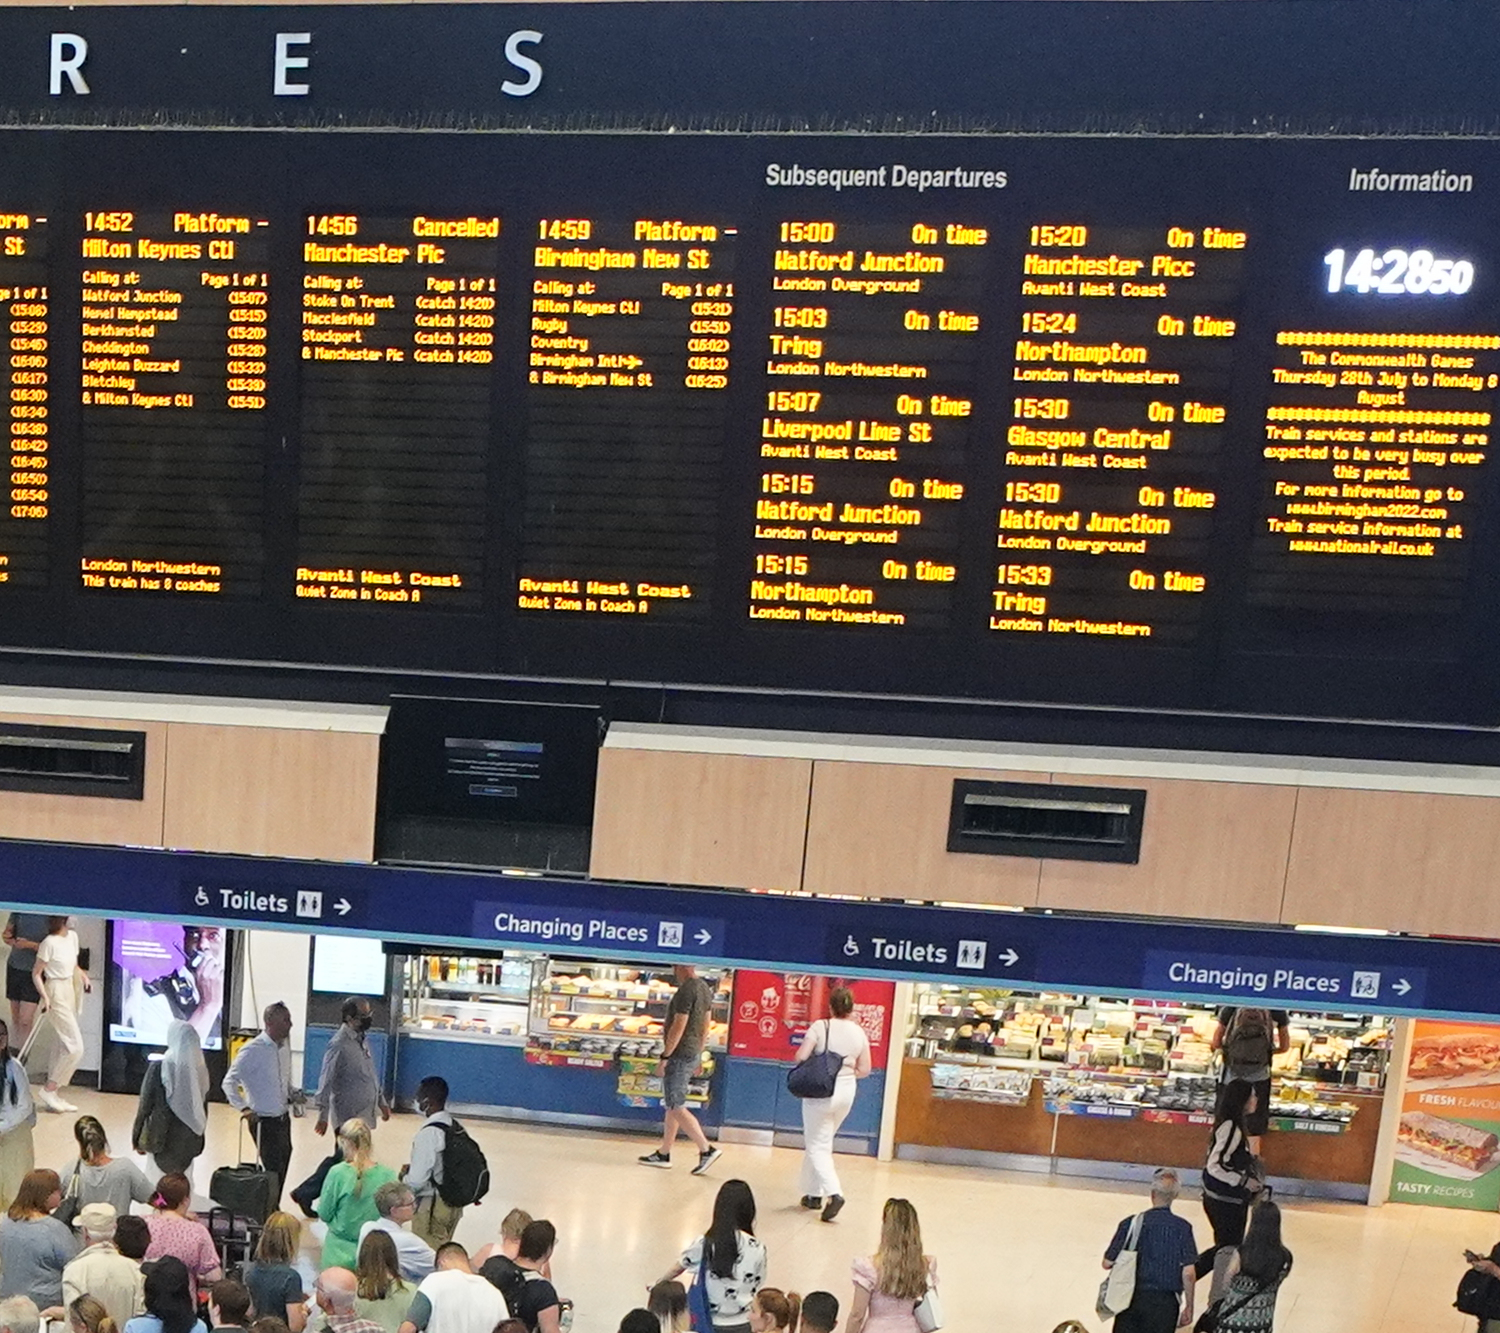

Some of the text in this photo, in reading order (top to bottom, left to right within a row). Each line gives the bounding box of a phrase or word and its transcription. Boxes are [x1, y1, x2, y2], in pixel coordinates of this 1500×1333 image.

[766, 164, 1007, 192] Subsequent Departures
[1349, 168, 1472, 191] Information
[85, 212, 250, 233] 14:52 Platform
[308, 215, 499, 237] 14:56 Cancelled
[540, 219, 717, 241] 14:59 Platform
[781, 222, 987, 245] 15:00 On time
[5, 236, 25, 255] St
[1031, 226, 1087, 246] 15:20
[83, 238, 131, 258] Milton
[138, 239, 201, 261] Keynes
[305, 243, 445, 263] Manchester Pic
[535, 247, 710, 270] Birmingham New St
[775, 250, 944, 272] Watford Junction
[1024, 254, 1195, 276] Manchester Picc
[775, 307, 979, 331] 15:03 On time
[770, 335, 823, 358] Tring
[768, 391, 971, 416] 15:07 On time
[763, 418, 932, 442] Liverpool Lime St
[220, 889, 287, 912] Toilets
[493, 911, 647, 942] Changing Places
[872, 938, 947, 963] Toilets
[1169, 963, 1340, 992] Changing Places
[1418, 1093, 1455, 1106] FRESH
[1396, 1180, 1476, 1199] TASTY RECIPES
